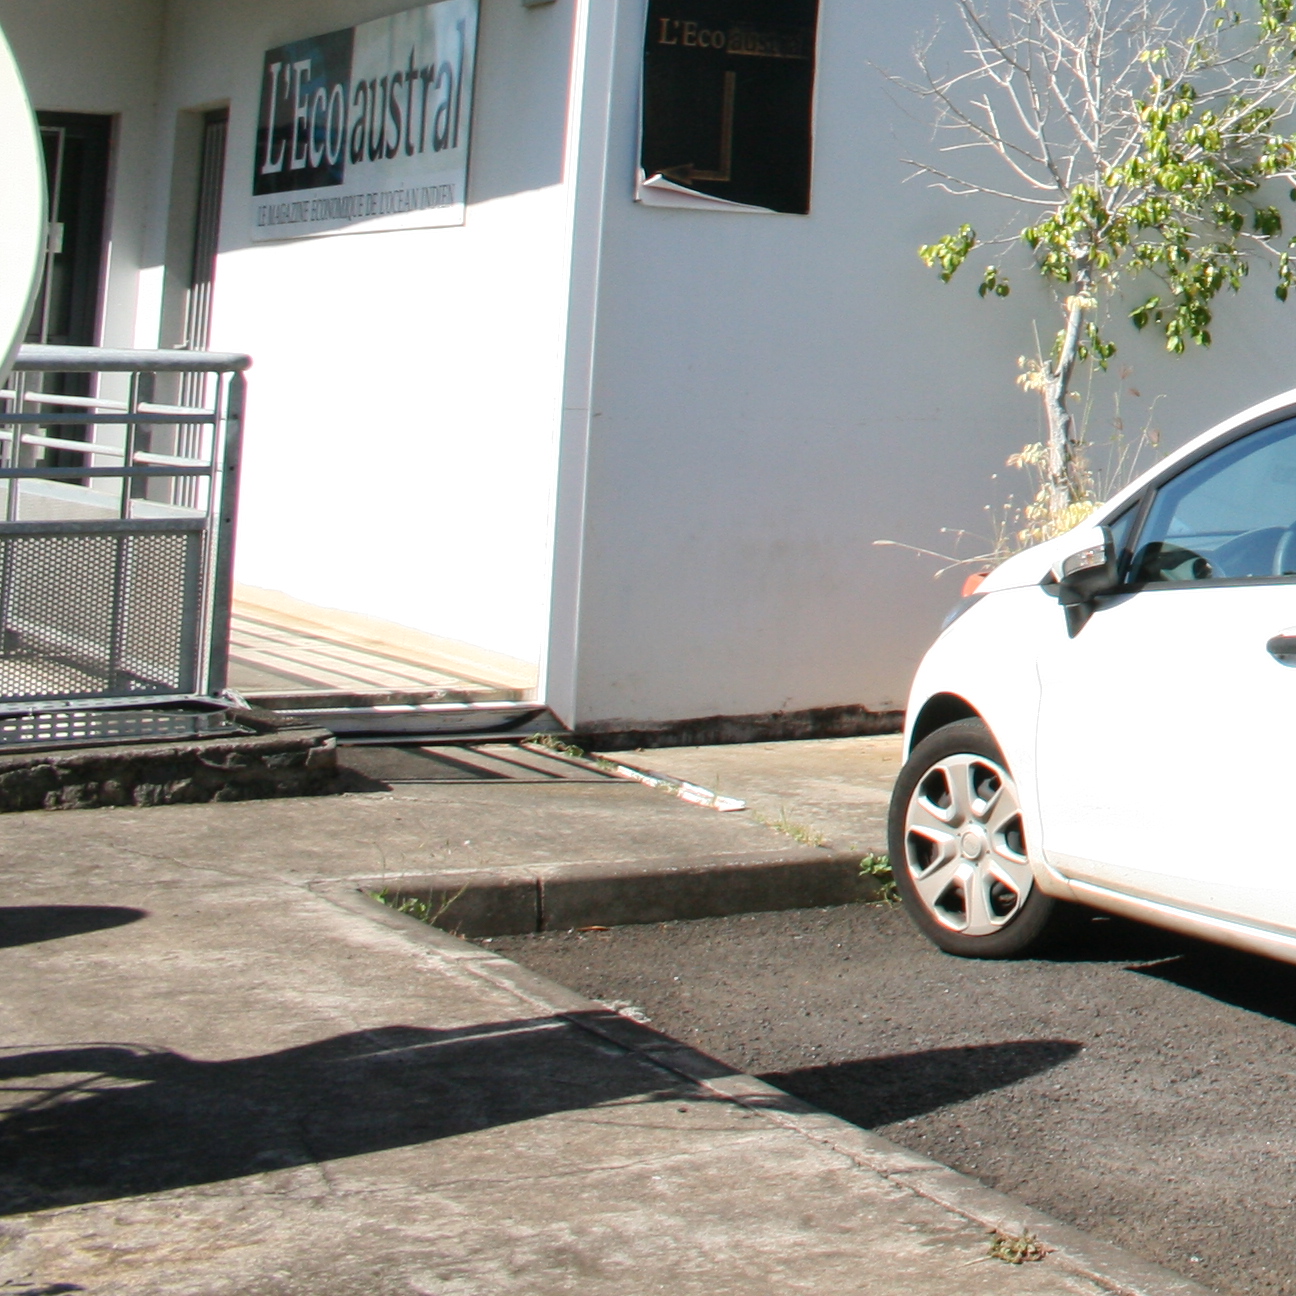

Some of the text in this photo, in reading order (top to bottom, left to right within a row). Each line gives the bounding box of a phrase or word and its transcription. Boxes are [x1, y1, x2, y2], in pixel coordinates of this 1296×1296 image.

[658, 17, 726, 49] L'Eco
[261, 18, 467, 175] L'Eco austral
[257, 205, 267, 227] LE
[268, 200, 310, 226] MAGAZINE
[365, 193, 377, 216] DE
[420, 183, 457, 211] INDIEN
